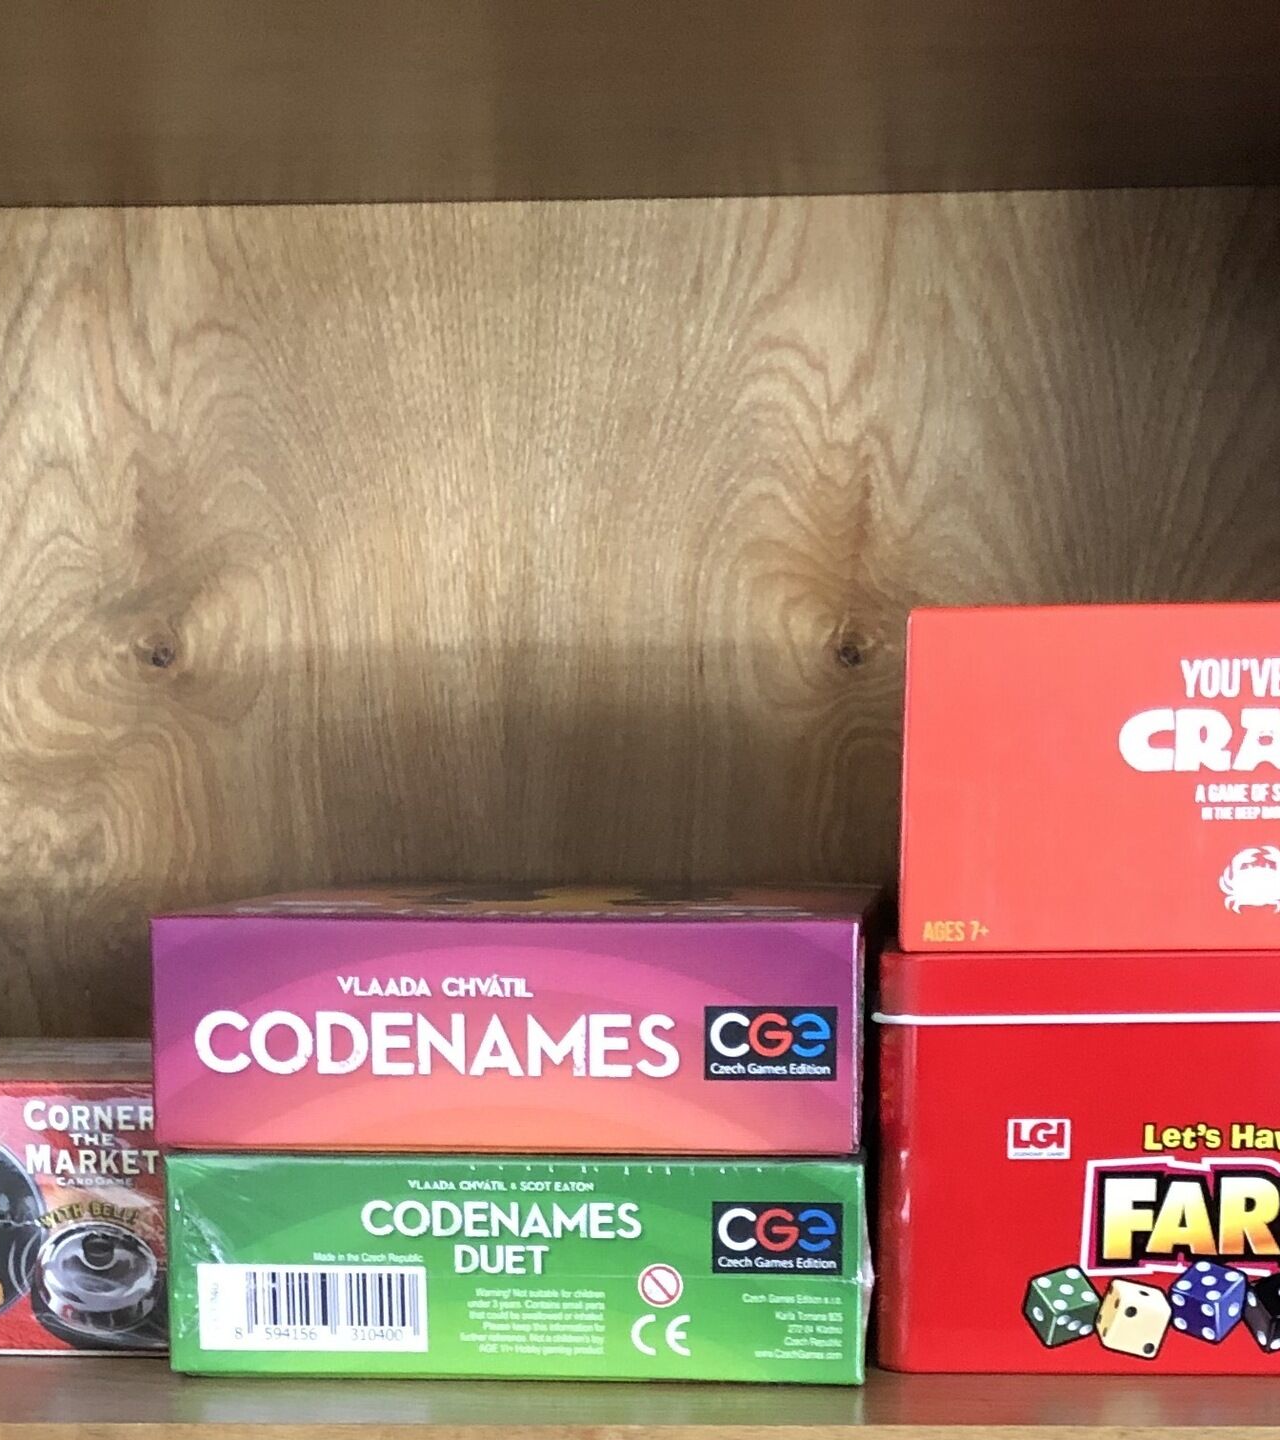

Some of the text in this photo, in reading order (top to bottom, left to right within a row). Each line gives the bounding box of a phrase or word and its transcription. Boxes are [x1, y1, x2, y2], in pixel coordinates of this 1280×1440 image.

[1194, 784, 1206, 803] A
[1208, 783, 1250, 803] GAME
[1251, 783, 1270, 802] OF
[923, 920, 989, 942] AGES 7+
[337, 972, 533, 998] VLAADA CHVÁTIL
[194, 1010, 680, 1079] CODENAMES
[709, 1062, 831, 1075] Czech Games Edition
[23, 1100, 154, 1131] CORNER
[69, 1133, 115, 1147] THE
[1013, 1122, 1065, 1149] LGI
[1144, 1123, 1221, 1151] Let's
[25, 1143, 159, 1175] MARKET
[407, 1179, 456, 1191] VLAADA
[519, 1180, 553, 1192] SCOT
[554, 1181, 595, 1193] EATON
[38, 1204, 84, 1229] WITH
[360, 1199, 643, 1240] CODENAMES
[454, 1243, 550, 1275] DUET
[717, 1255, 837, 1269] Czech Games Edition
